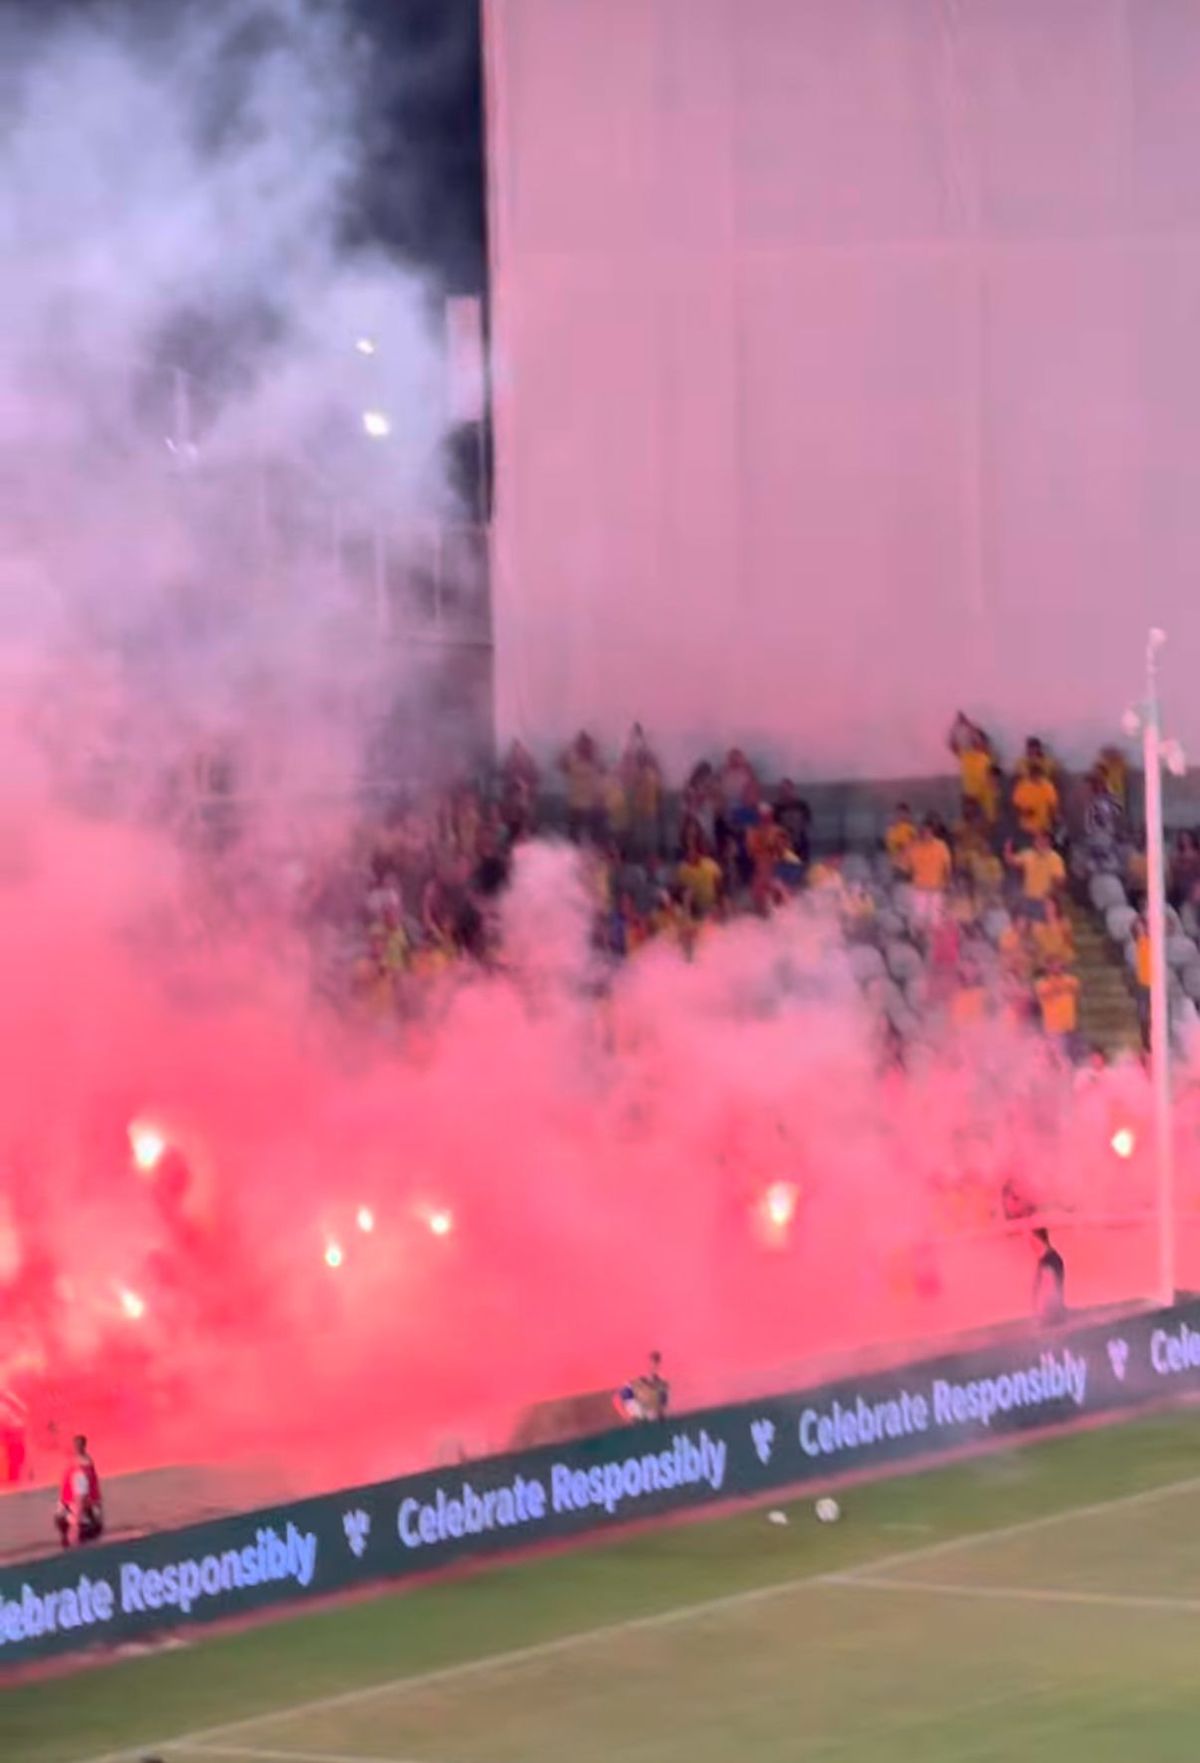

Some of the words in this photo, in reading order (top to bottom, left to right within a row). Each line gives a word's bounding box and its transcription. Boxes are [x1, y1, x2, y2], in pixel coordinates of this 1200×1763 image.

[798, 1391, 928, 1456] Celebrate
[932, 1348, 1088, 1425] Responsibly
[398, 1475, 546, 1548] Celebrate
[550, 1430, 727, 1512] Responsibly
[120, 1521, 317, 1613] Responsibly
